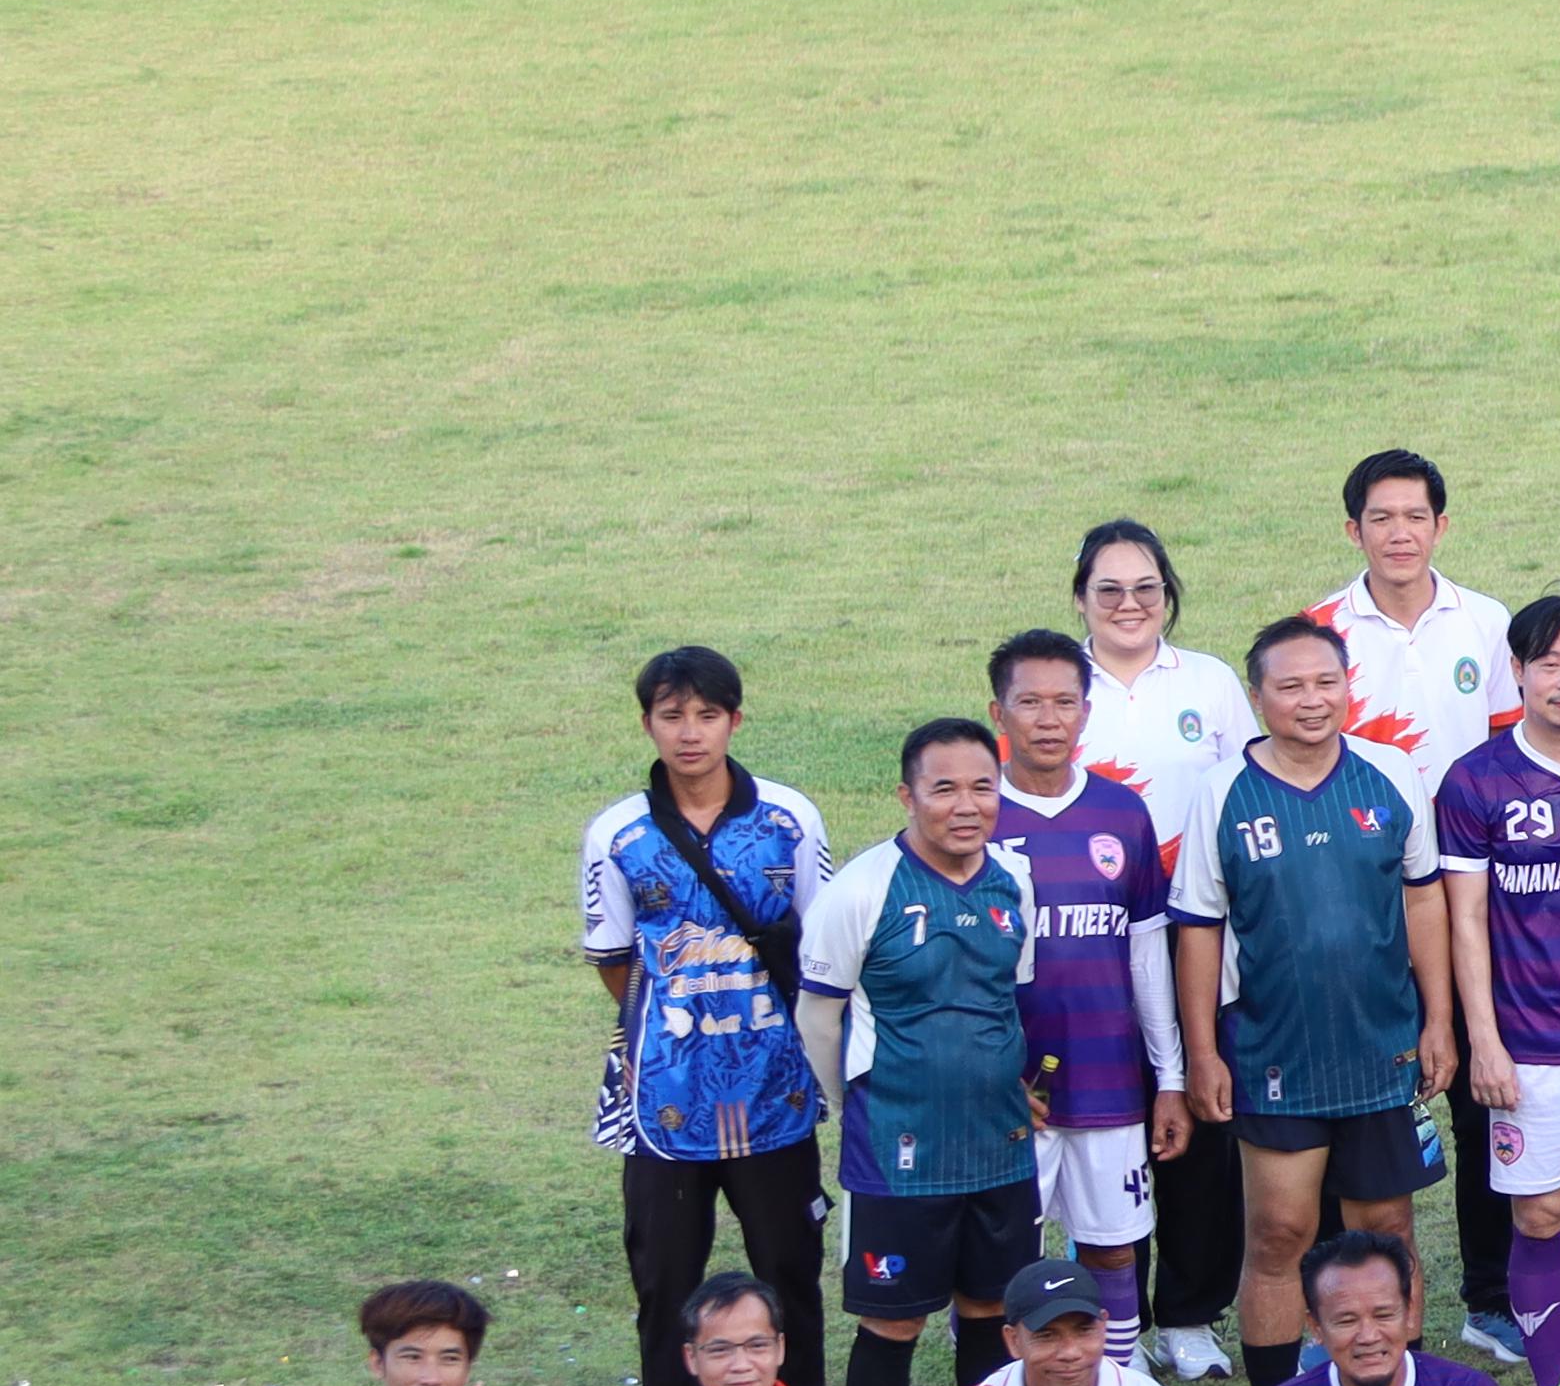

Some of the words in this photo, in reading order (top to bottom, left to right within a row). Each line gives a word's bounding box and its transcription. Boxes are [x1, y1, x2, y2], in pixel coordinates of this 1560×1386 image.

[1505, 798, 1554, 842] 29
[904, 904, 928, 946] 7
[1058, 904, 1111, 938] TREE
